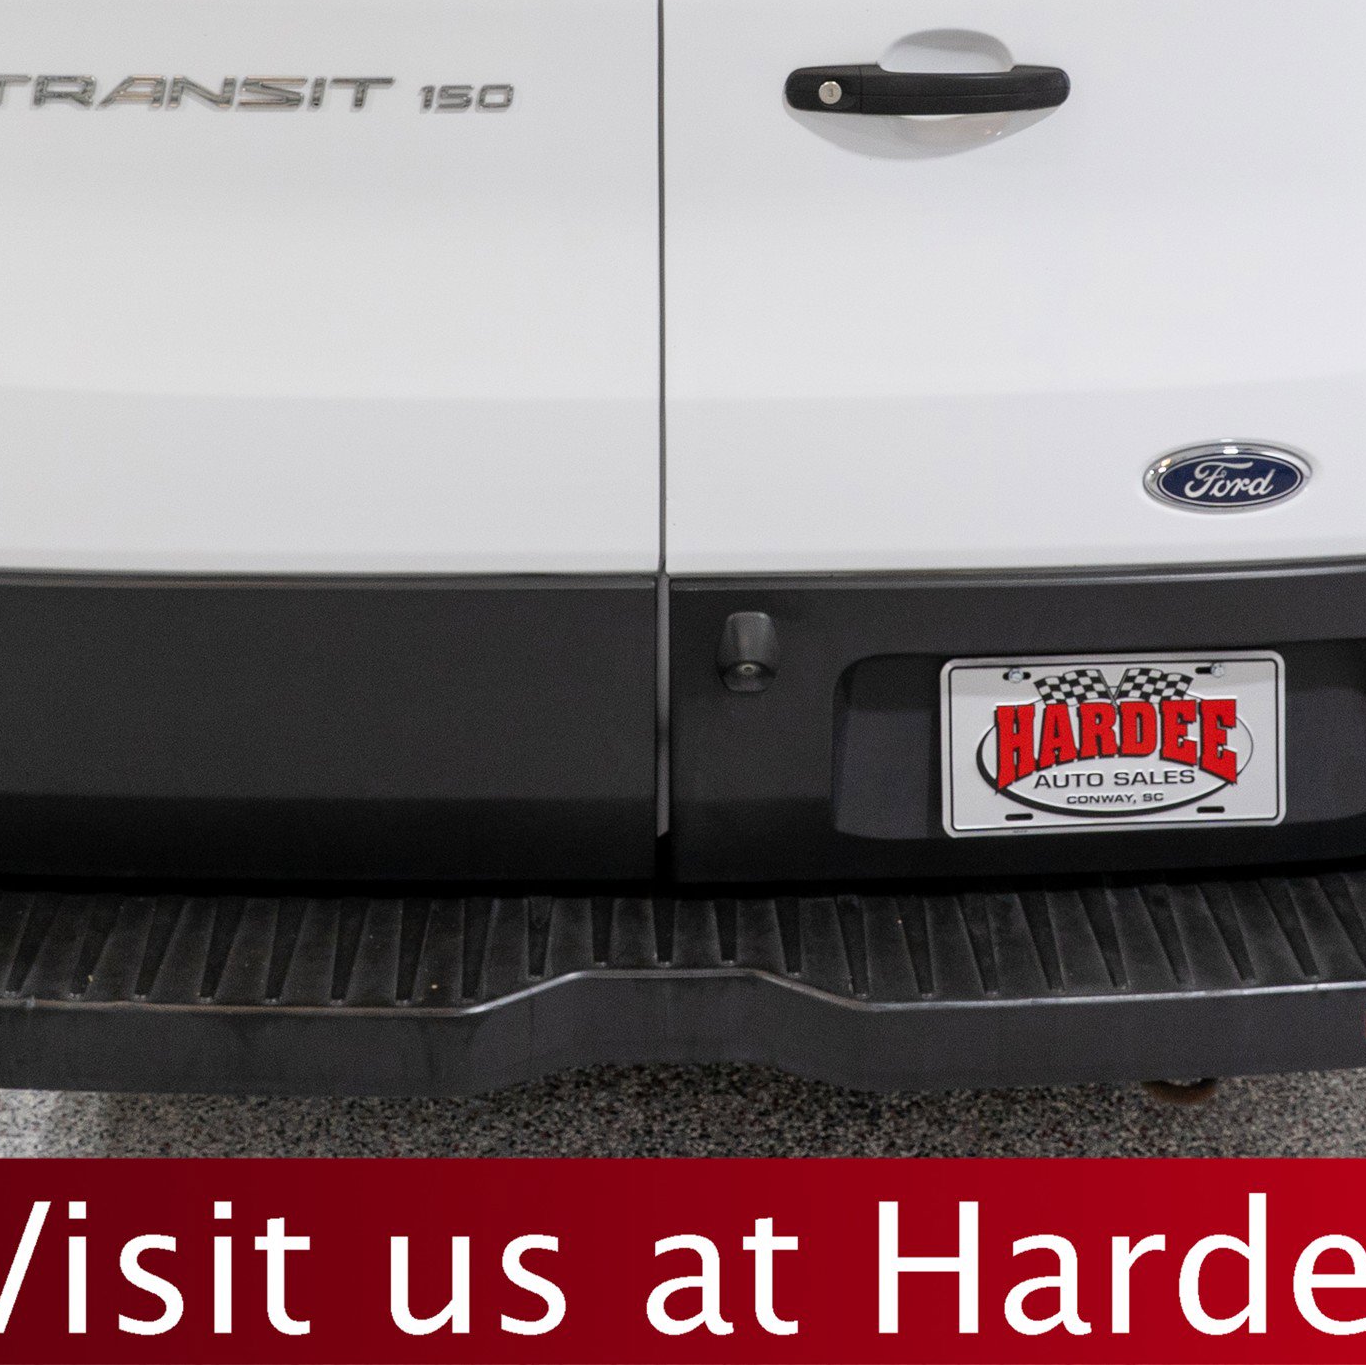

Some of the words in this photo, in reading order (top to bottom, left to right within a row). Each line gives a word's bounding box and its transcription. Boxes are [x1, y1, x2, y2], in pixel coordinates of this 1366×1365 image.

[419, 83, 515, 112] 150
[1184, 460, 1276, 498] Ford
[995, 698, 1238, 793] HARDEE
[1033, 772, 1105, 790] AUTO
[1113, 769, 1196, 786] SALES
[1066, 794, 1137, 806] CONWAY,
[1143, 792, 1165, 803] SC
